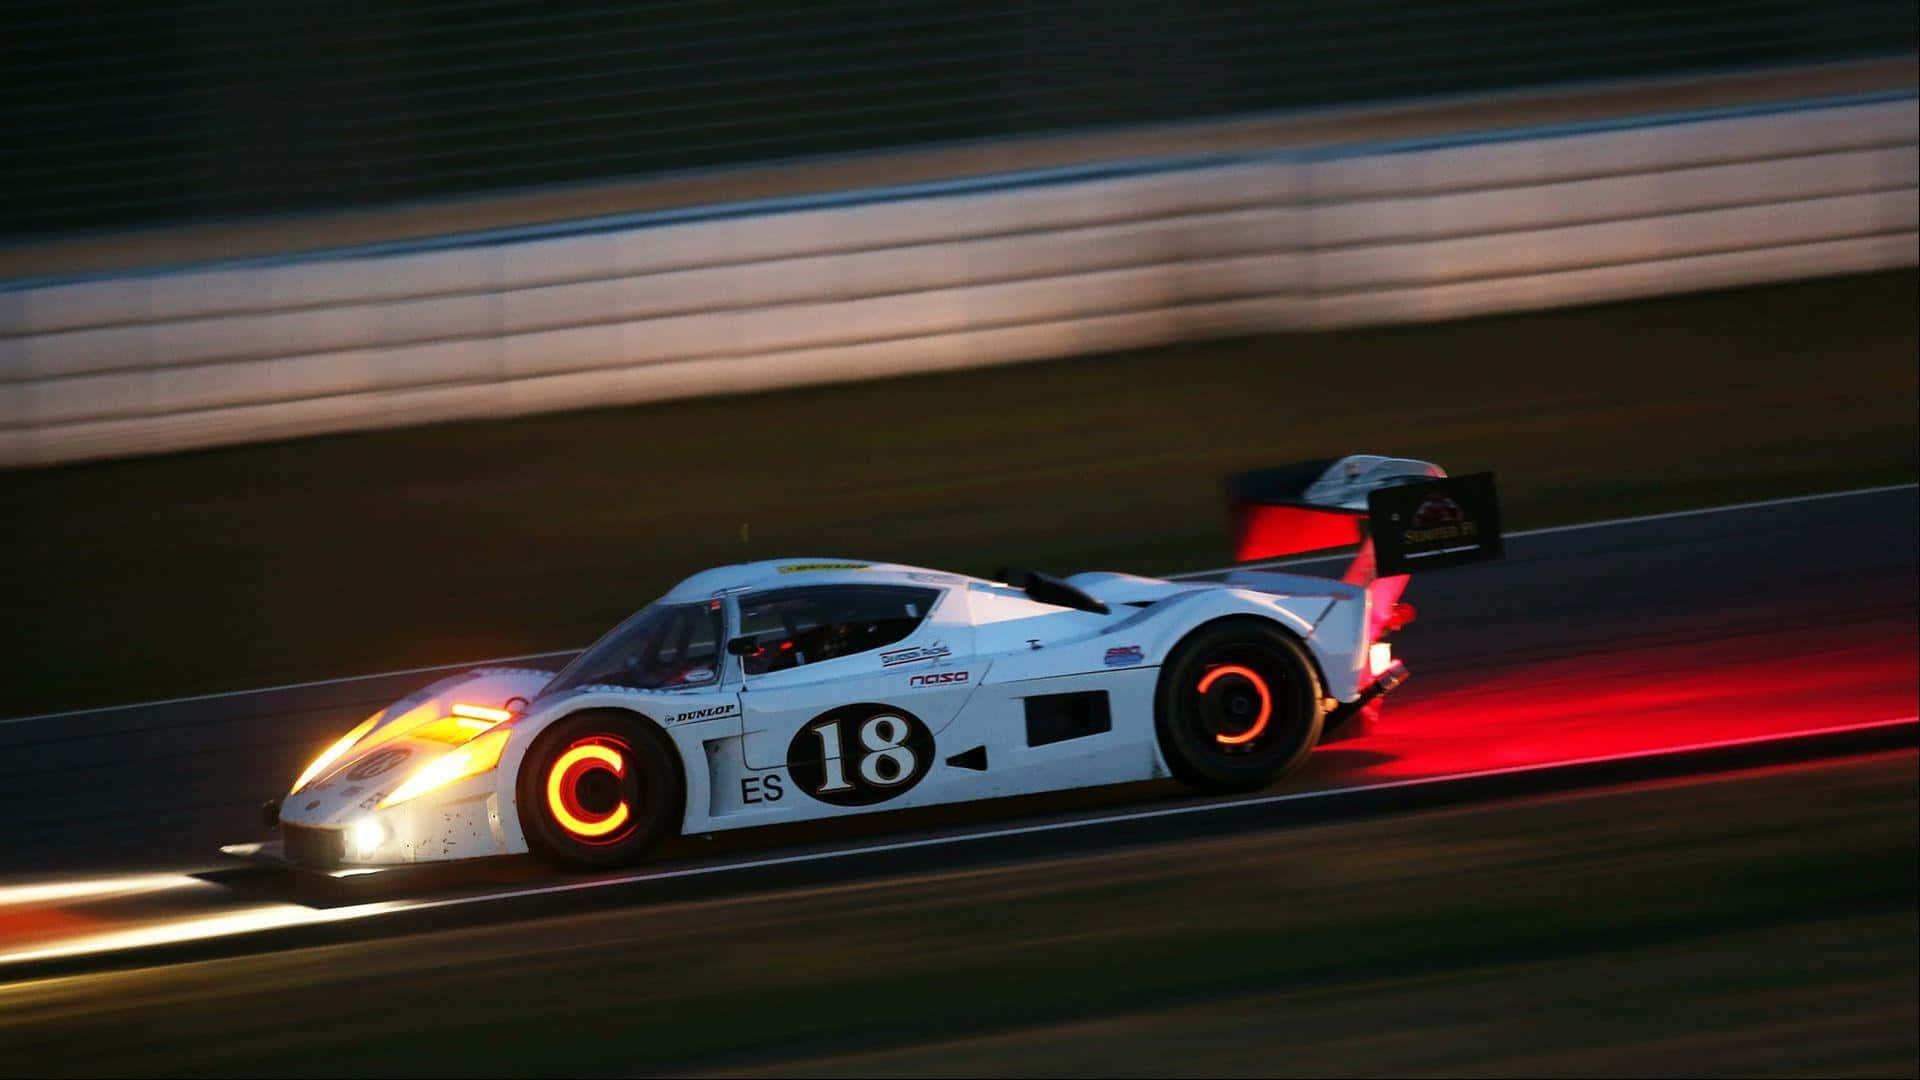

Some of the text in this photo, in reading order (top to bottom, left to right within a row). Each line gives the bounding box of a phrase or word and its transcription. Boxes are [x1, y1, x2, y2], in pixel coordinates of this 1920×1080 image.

[676, 704, 735, 722] DUNLOP
[812, 713, 919, 795] 18
[741, 774, 783, 804] ES
